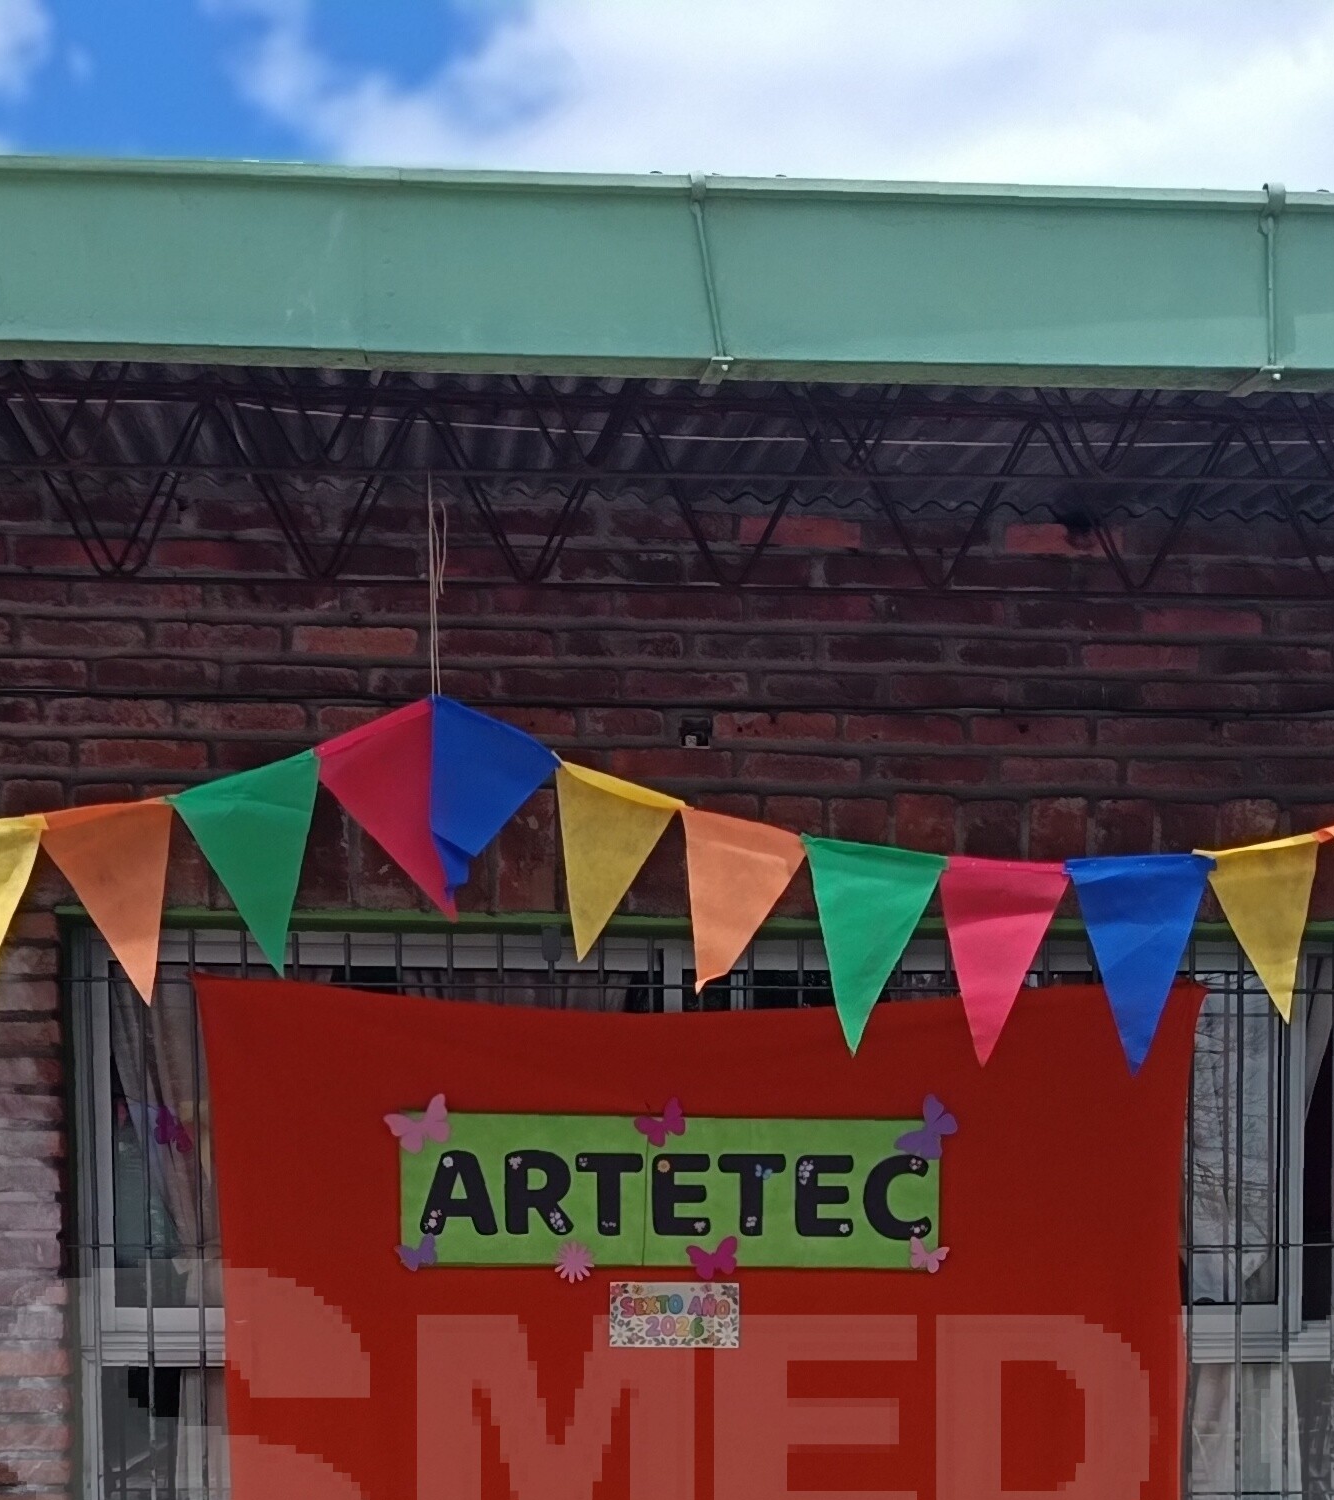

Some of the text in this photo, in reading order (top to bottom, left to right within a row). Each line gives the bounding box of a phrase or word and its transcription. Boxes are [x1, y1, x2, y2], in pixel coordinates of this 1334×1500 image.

[419, 1149, 931, 1243] ARTETEC
[620, 1293, 731, 1319] SEXTO AÑO
[645, 1315, 705, 1338] 2026
